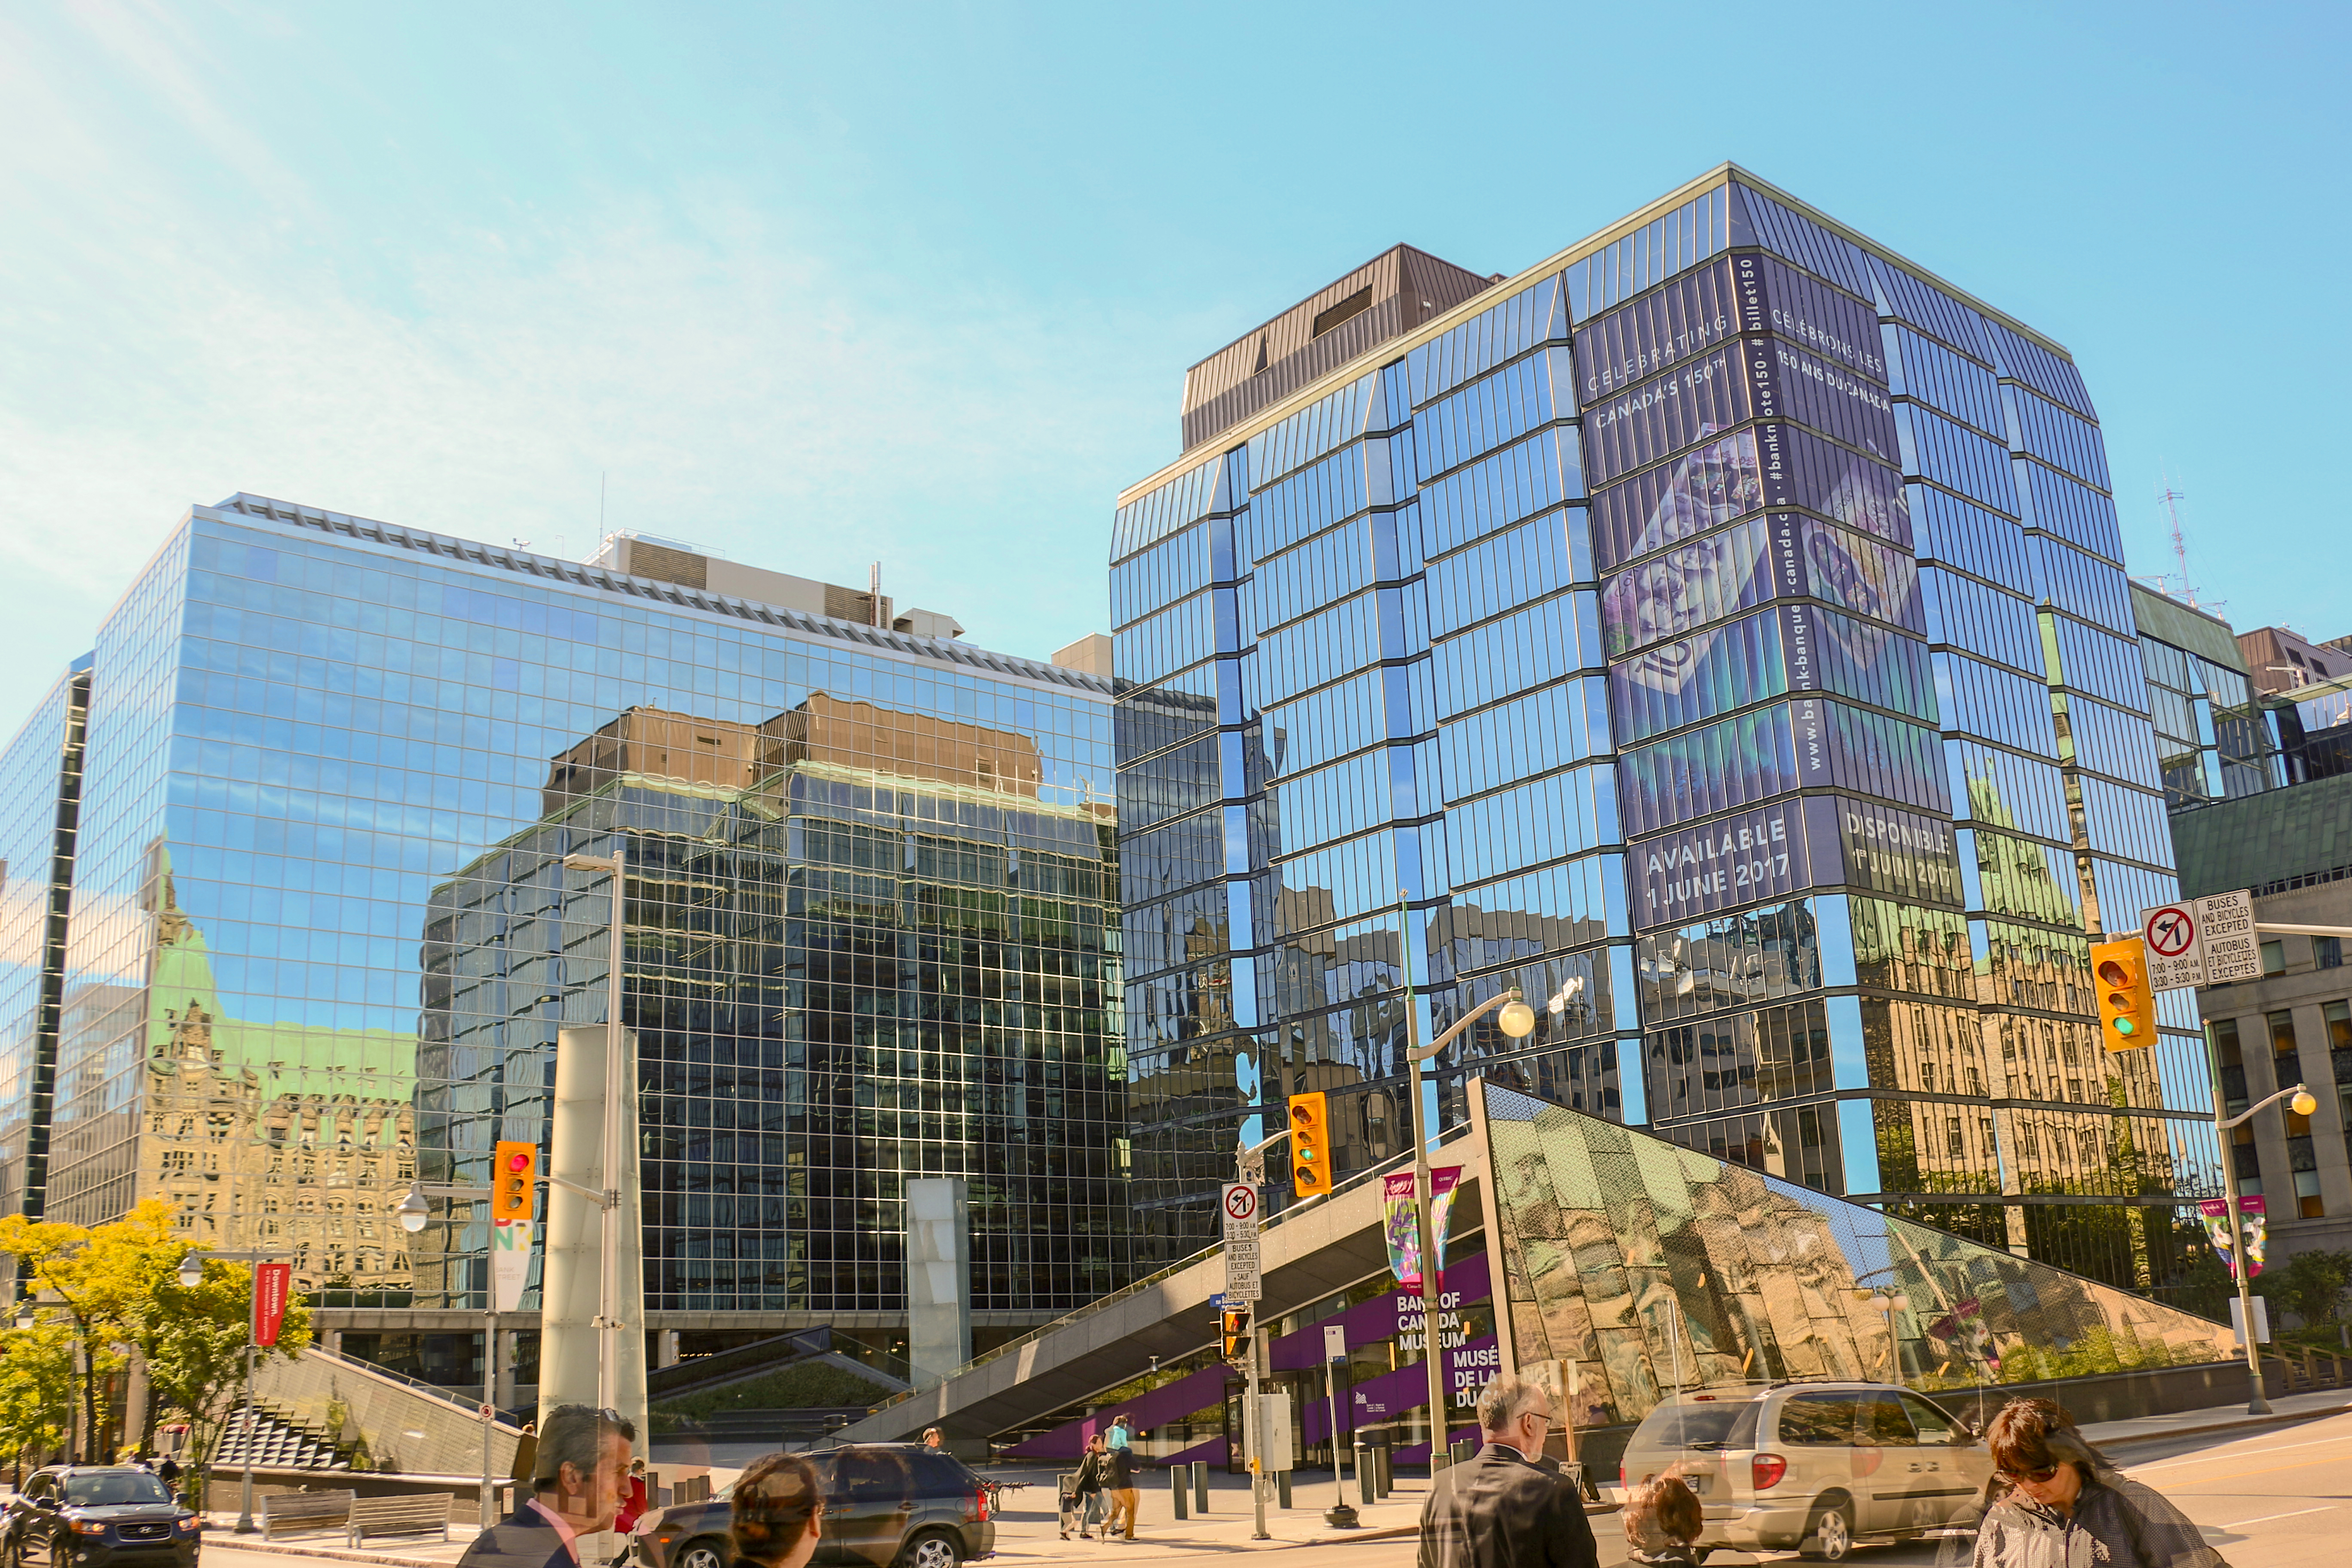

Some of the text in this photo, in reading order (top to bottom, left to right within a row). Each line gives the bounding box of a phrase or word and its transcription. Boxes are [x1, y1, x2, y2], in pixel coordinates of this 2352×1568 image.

[1740, 259, 1764, 346] #billet150
[1773, 309, 1882, 372] CÉLÉBRONS LES
[1588, 315, 1727, 392] CELEBRATING
[1777, 350, 1891, 413] 150 ANS DU CANADA
[1596, 381, 1678, 429] CANADA'S
[1754, 360, 1782, 480] #banknote150
[1635, 635, 1691, 678] 10
[1847, 812, 1950, 855] DISPONIBLE
[1646, 818, 1785, 876] AVAILABLE
[1870, 851, 1911, 879] JUIN
[1916, 861, 1952, 887] 2017
[1646, 853, 1788, 909] 1 JUNE 2017
[2207, 896, 2239, 910] BUSES
[2202, 906, 2249, 924] AND BICYCLES
[2205, 919, 2248, 936] EXCEPTED
[2211, 938, 2250, 954] AUTOBUS
[2152, 962, 2165, 974] 7:00
[2173, 959, 2188, 971] 9:00
[2208, 949, 2256, 967] ET BICYCLETTES
[2153, 975, 2168, 988] 3:30
[2175, 971, 2190, 984] 5:30
[1226, 1231, 1235, 1240] 3:30
[1232, 1244, 1252, 1252] BUSES
[1238, 1253, 1258, 1261] BICYCLES
[1231, 1262, 1255, 1270] EXCEPTED
[271, 1269, 281, 1317] Downtown.
[1229, 1282, 1251, 1290] AUTOBUS
[1229, 1290, 1259, 1298] BICYCLETTES
[1440, 1292, 1460, 1309] OF
[1398, 1312, 1460, 1332] CANDA
[1454, 1369, 1497, 1388] DE LA
[1456, 1391, 1477, 1408] DU
